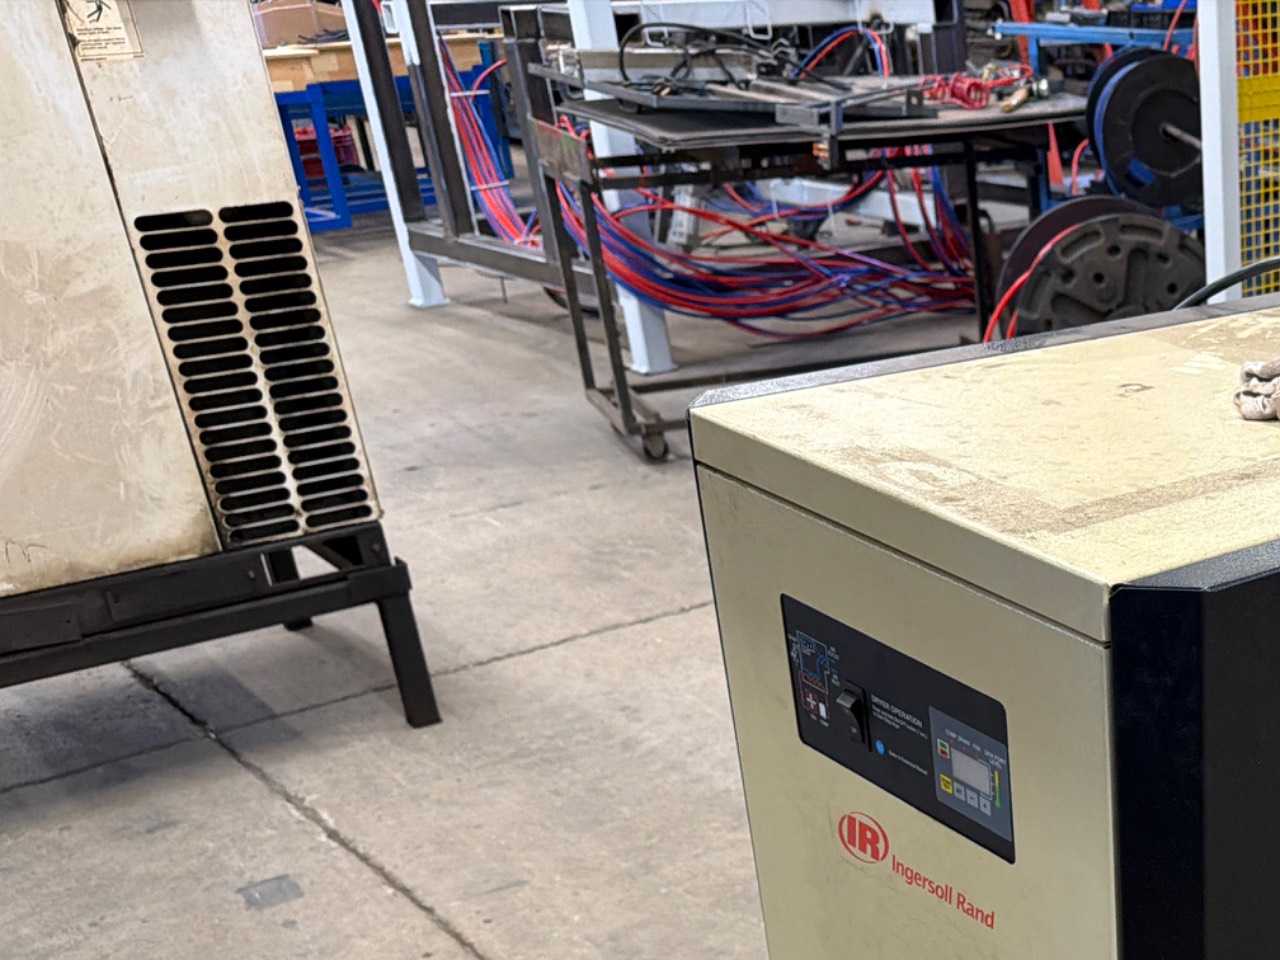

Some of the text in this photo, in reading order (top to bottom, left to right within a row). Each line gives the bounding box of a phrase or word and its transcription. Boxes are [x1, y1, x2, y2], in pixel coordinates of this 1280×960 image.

[891, 704, 923, 728] OPERATION
[847, 814, 880, 861] IR
[891, 855, 995, 929] Ingersoll Rand
